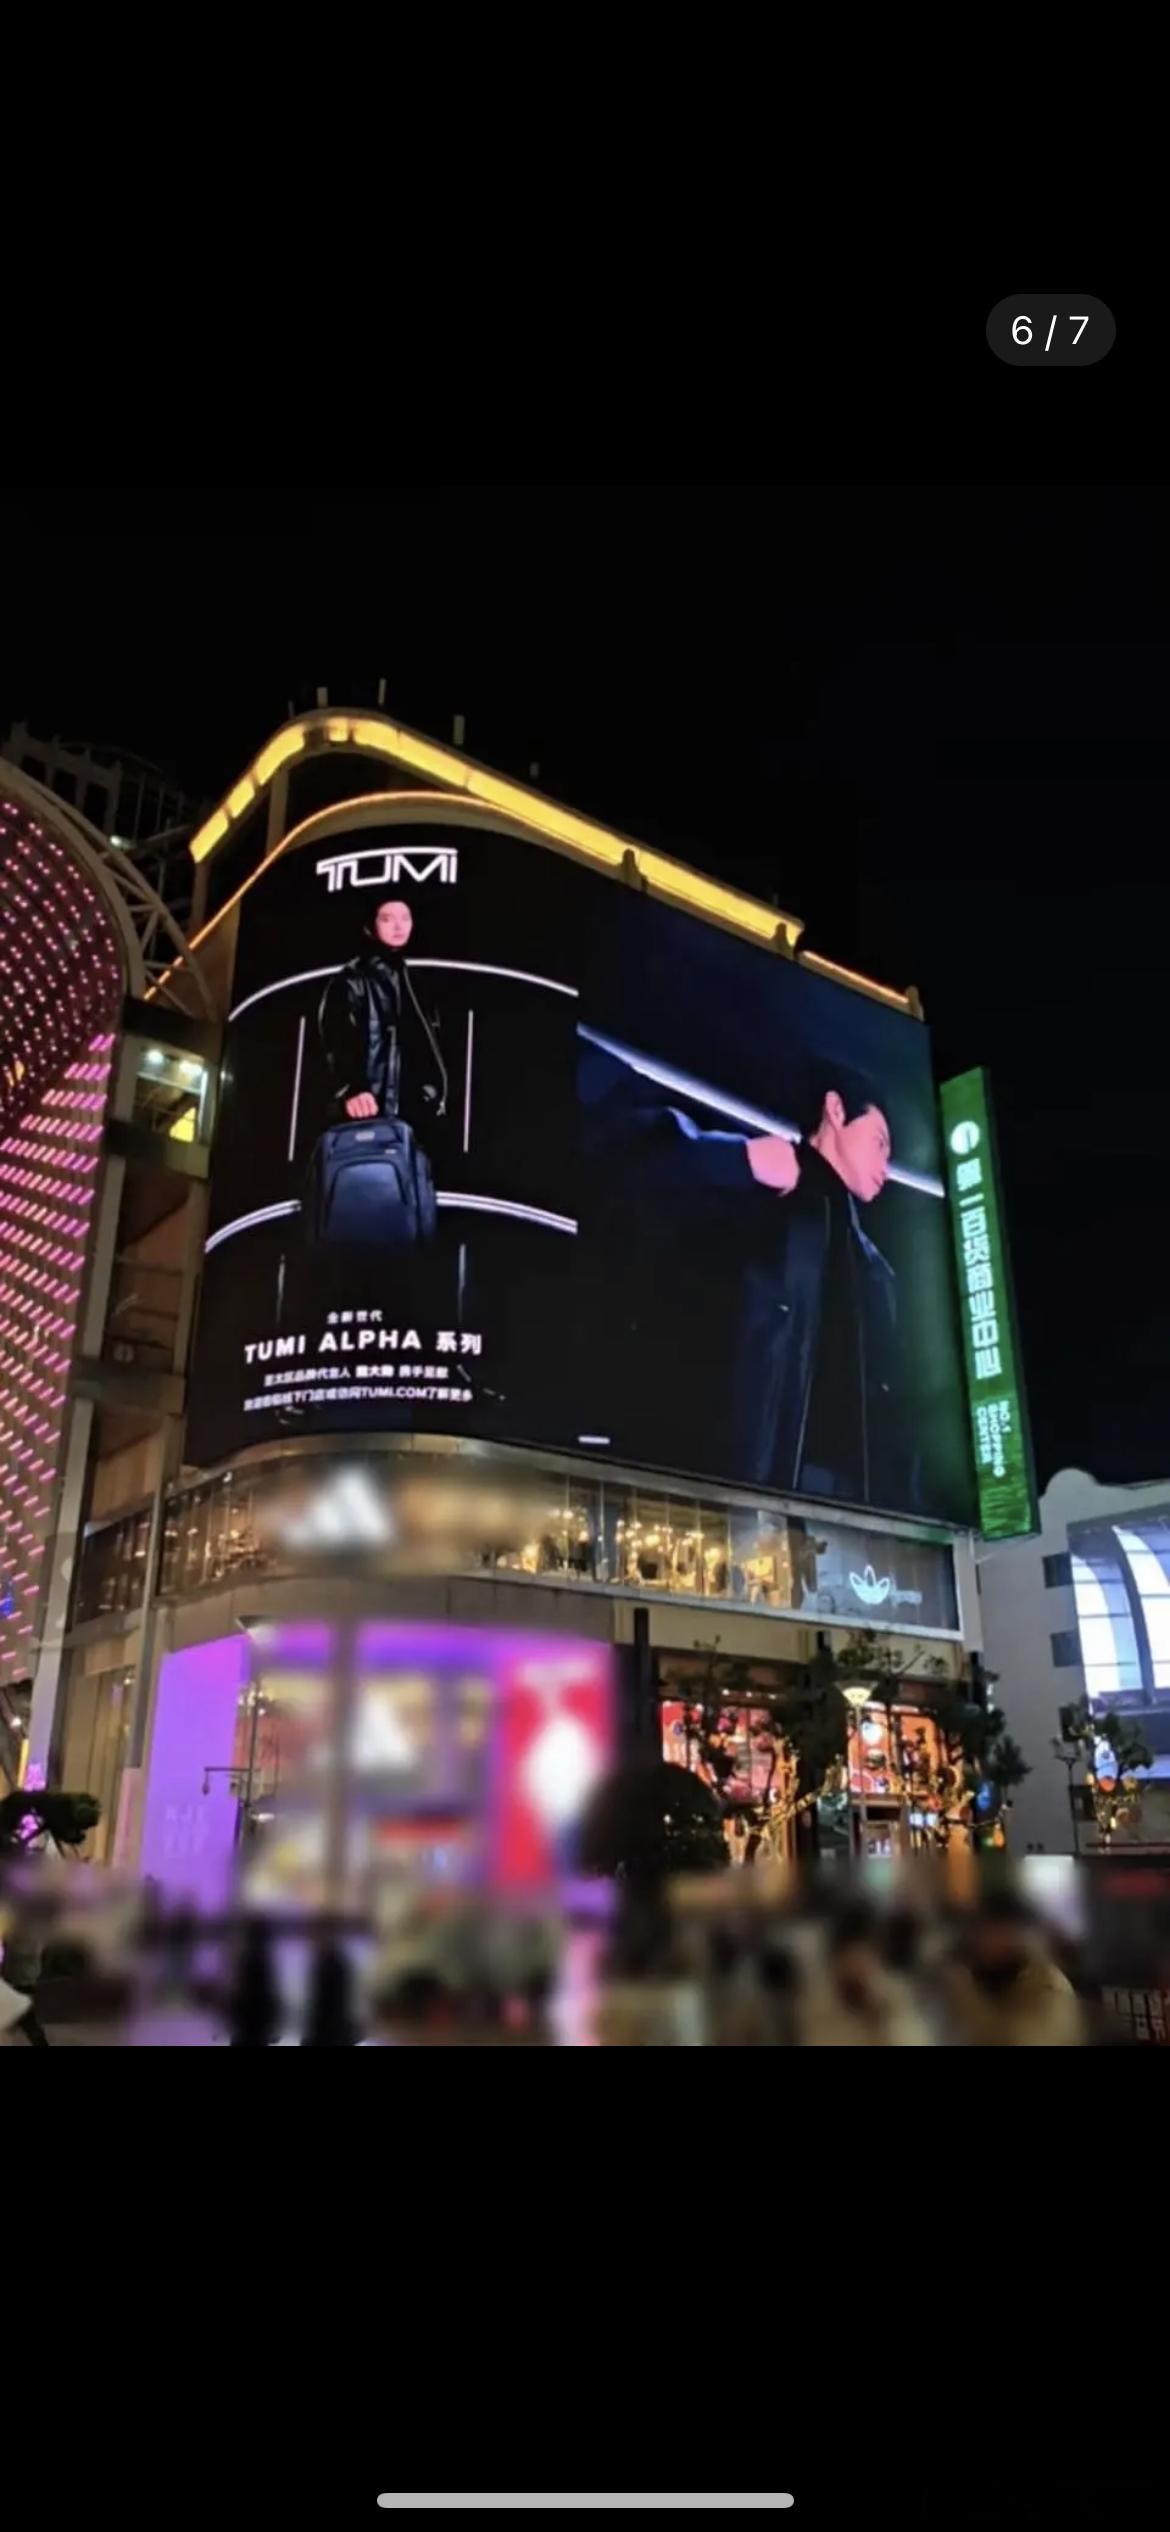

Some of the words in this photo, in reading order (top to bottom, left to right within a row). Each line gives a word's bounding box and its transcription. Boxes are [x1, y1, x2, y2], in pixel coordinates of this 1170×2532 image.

[316, 846, 458, 892] TUMI
[244, 1334, 306, 1364] TUMI
[318, 1329, 422, 1352] ALPHA
[436, 1331, 482, 1356] 系列
